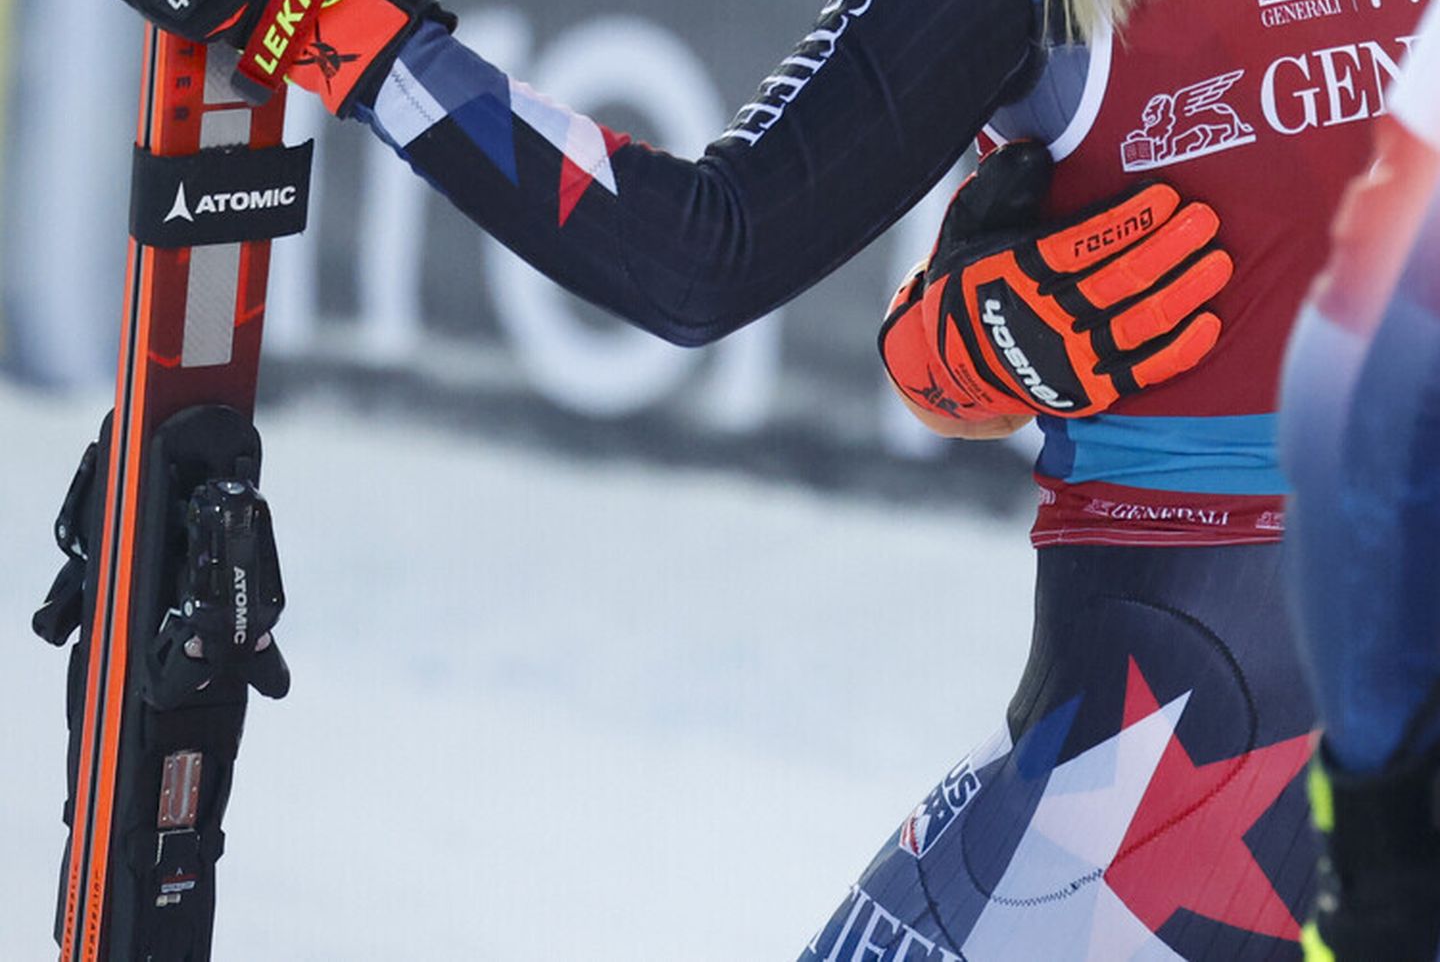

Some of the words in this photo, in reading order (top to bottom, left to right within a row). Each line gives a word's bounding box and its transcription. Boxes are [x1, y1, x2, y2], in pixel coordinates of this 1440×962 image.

[1260, 35, 1420, 135] GEN
[195, 185, 297, 215] ATOMIC
[1074, 206, 1155, 259] racing
[982, 298, 1075, 409] reusch
[1111, 503, 1230, 526] GENERALI
[234, 565, 249, 646] ATOMIC
